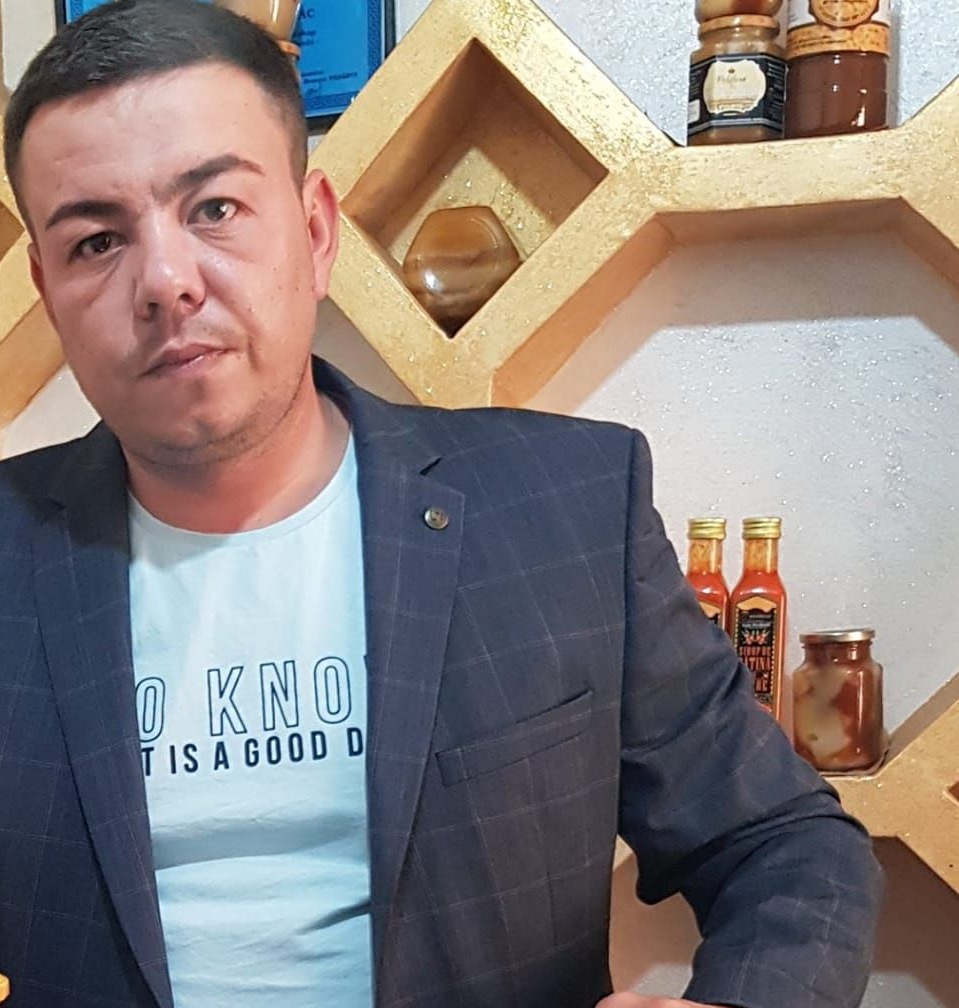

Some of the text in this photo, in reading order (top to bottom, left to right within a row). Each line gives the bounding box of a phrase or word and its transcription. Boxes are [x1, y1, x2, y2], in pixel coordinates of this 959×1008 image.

[207, 656, 352, 737] KNO
[142, 727, 364, 777] T IS A GOOD D
